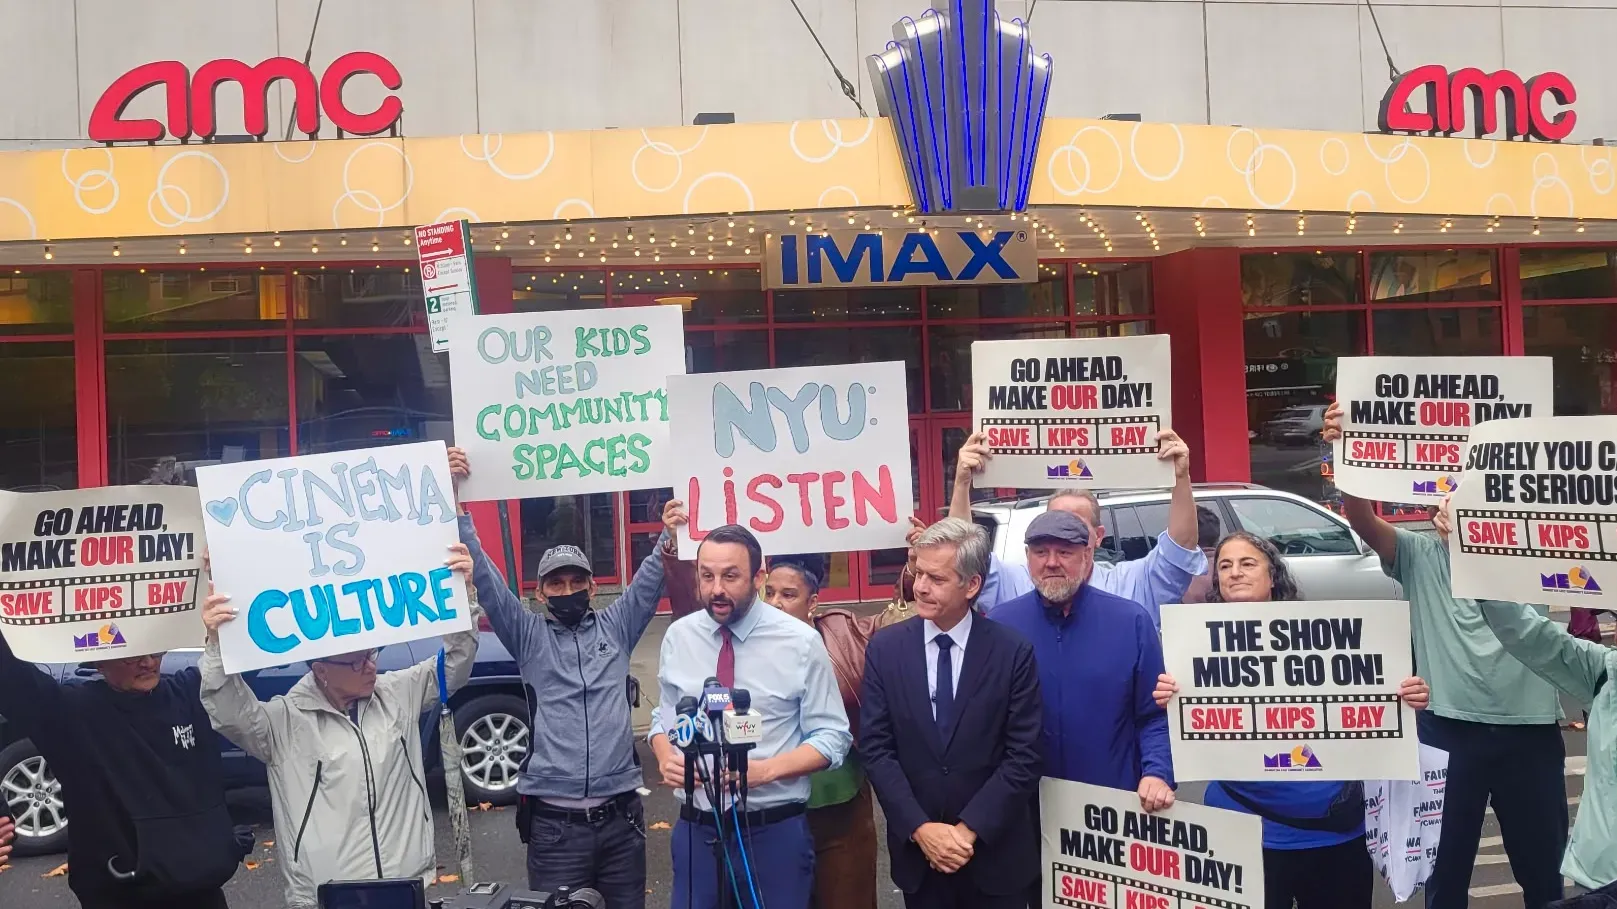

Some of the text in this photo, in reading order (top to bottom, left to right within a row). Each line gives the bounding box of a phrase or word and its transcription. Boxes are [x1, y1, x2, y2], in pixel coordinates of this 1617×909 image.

[418, 224, 455, 238] NO STANDING
[420, 236, 443, 247] Anytime
[430, 297, 439, 313] 2
[477, 324, 652, 364] OUR KIDS
[515, 361, 598, 399] NEED
[1010, 356, 1128, 383] GO AHEAD,
[988, 382, 1153, 410] MAKE OUR DAY!
[1375, 373, 1505, 402] GO AHEAD,
[476, 388, 670, 441] COMMUNITY
[712, 382, 878, 458] NYU:
[1350, 400, 1416, 425] MAKE
[1419, 401, 1470, 427] OUR
[988, 426, 1148, 447] SAVE KIPS BAY
[1352, 440, 1460, 464] SAVE KIPS
[511, 432, 652, 481] SPACES
[1465, 441, 1540, 471] SURELY
[1543, 441, 1592, 471] YOU
[238, 456, 456, 532] CINEMA
[1485, 474, 1617, 505] BE SERIOU
[34, 503, 167, 536] GO AHEAD,
[1467, 521, 1590, 549] SAVE KIPS
[1, 532, 194, 572] MAKE OUR DAY!
[303, 521, 366, 577] IS
[0, 581, 187, 616] SAVE KIPS BAY
[248, 567, 458, 654] CULTURE
[1205, 618, 1363, 652] THE SHOW
[1193, 654, 1385, 688] MUST GO ON!
[1191, 705, 1386, 730] SAVE KIPS BAY
[1084, 803, 1214, 858] GO AHEAD,
[1060, 828, 1243, 894] MAKE OUR DAY!
[1061, 875, 1107, 905] SAVE
